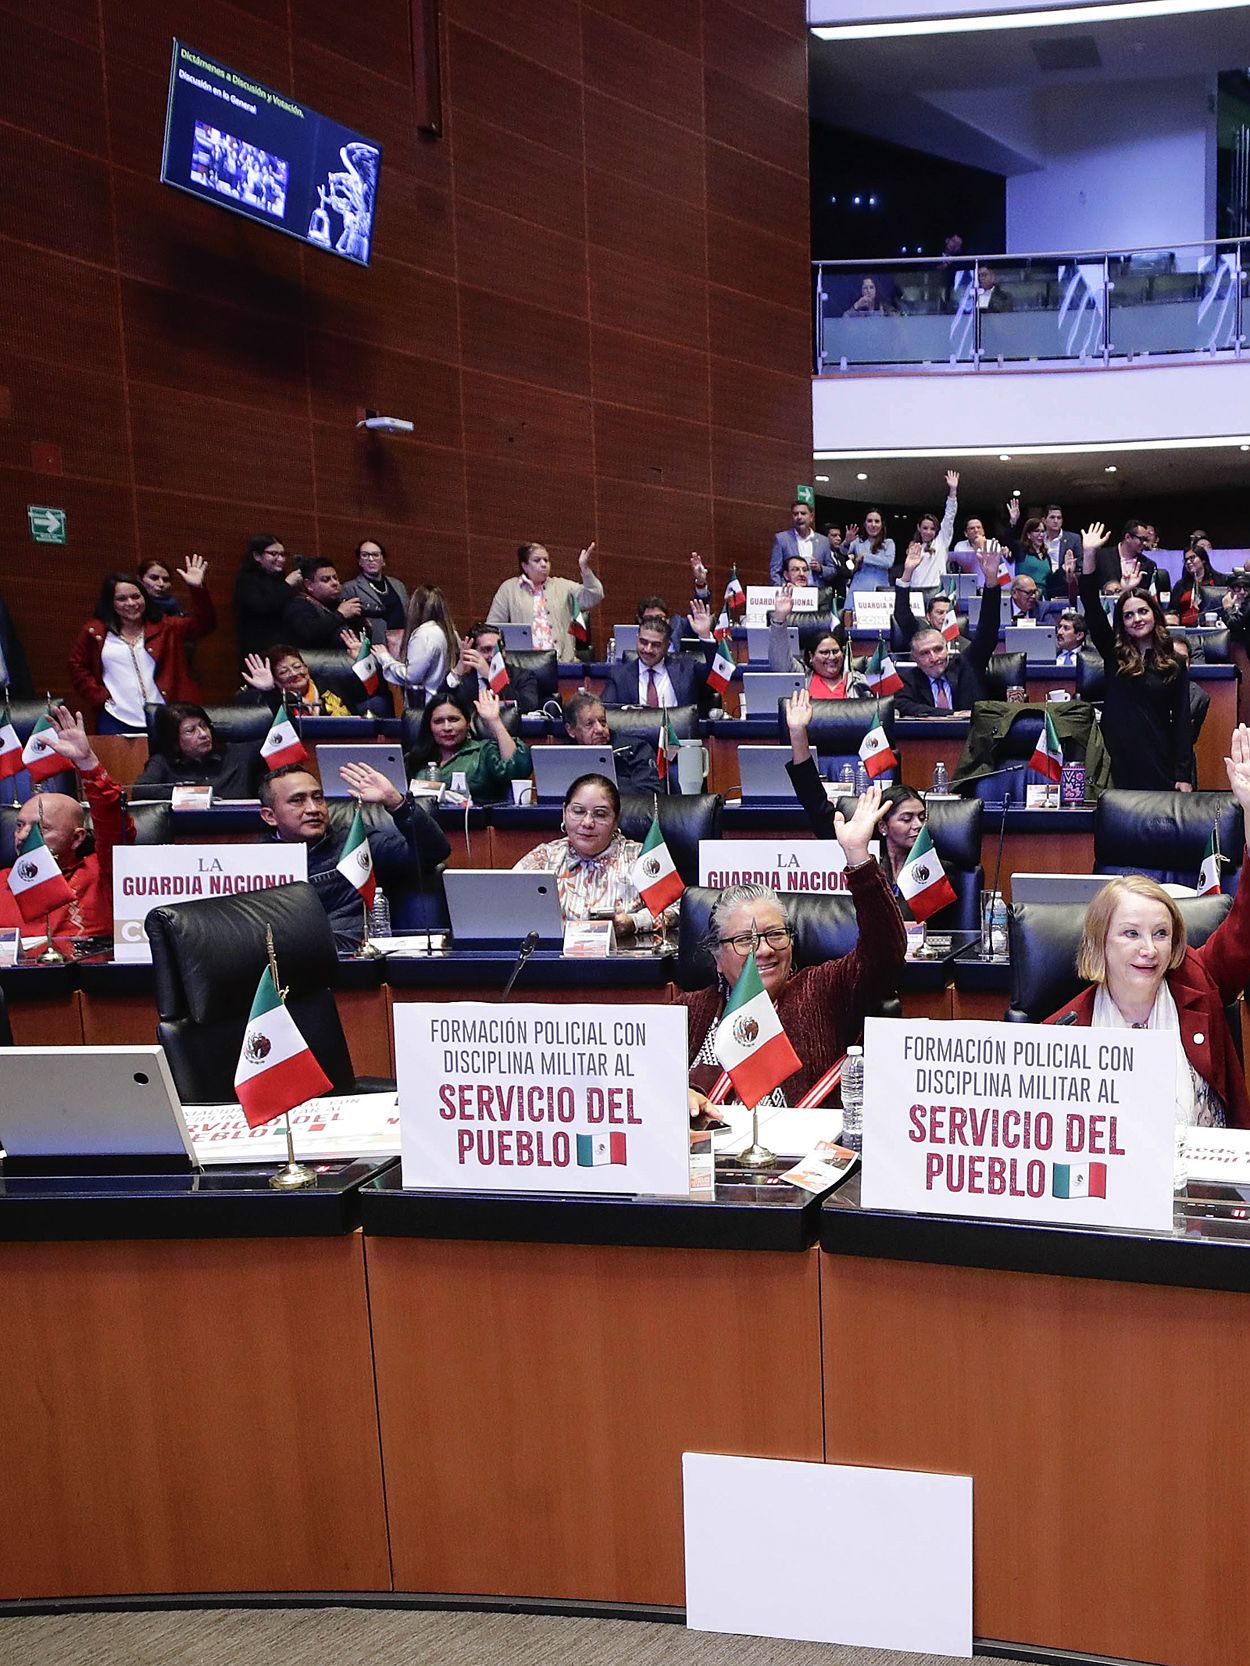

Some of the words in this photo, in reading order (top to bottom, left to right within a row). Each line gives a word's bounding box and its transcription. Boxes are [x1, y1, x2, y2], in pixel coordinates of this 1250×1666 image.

[181, 48, 226, 79] Dictámenes
[232, 74, 266, 99] Discusión
[179, 69, 213, 93] Discusión
[212, 86, 222, 98] en
[230, 94, 257, 115] General
[750, 597, 776, 606] GUARDI
[858, 601, 887, 610] GUARDIA
[198, 858, 224, 873] LA
[777, 853, 801, 868] LA
[122, 876, 203, 896] GUARDIA
[787, 871, 850, 892] NACION
[431, 1017, 527, 1044] FORMACIÓN
[534, 1021, 607, 1045] POLICIAL
[614, 1022, 645, 1046] CON
[444, 1050, 534, 1074] DISCIPLINA
[541, 1052, 608, 1076] MILITAR
[615, 1053, 634, 1076] AL
[905, 1036, 1005, 1065] FORMACIÓN
[1014, 1041, 1091, 1069] POLICIAL
[1099, 1045, 1133, 1071] CON
[917, 1069, 1012, 1098] DISCIPLINA
[1019, 1074, 1090, 1102] MILITAR
[1098, 1079, 1119, 1104] AL
[439, 1084, 575, 1123] SERVICIO
[586, 1087, 642, 1124] DEL
[291, 1113, 344, 1124] DEL
[909, 1104, 1053, 1151] SERVICIO
[1066, 1114, 1125, 1155] DEL
[191, 1129, 269, 1143] EBLO
[457, 1129, 570, 1167] PUEBLO
[926, 1153, 1045, 1198] PUEBLO
